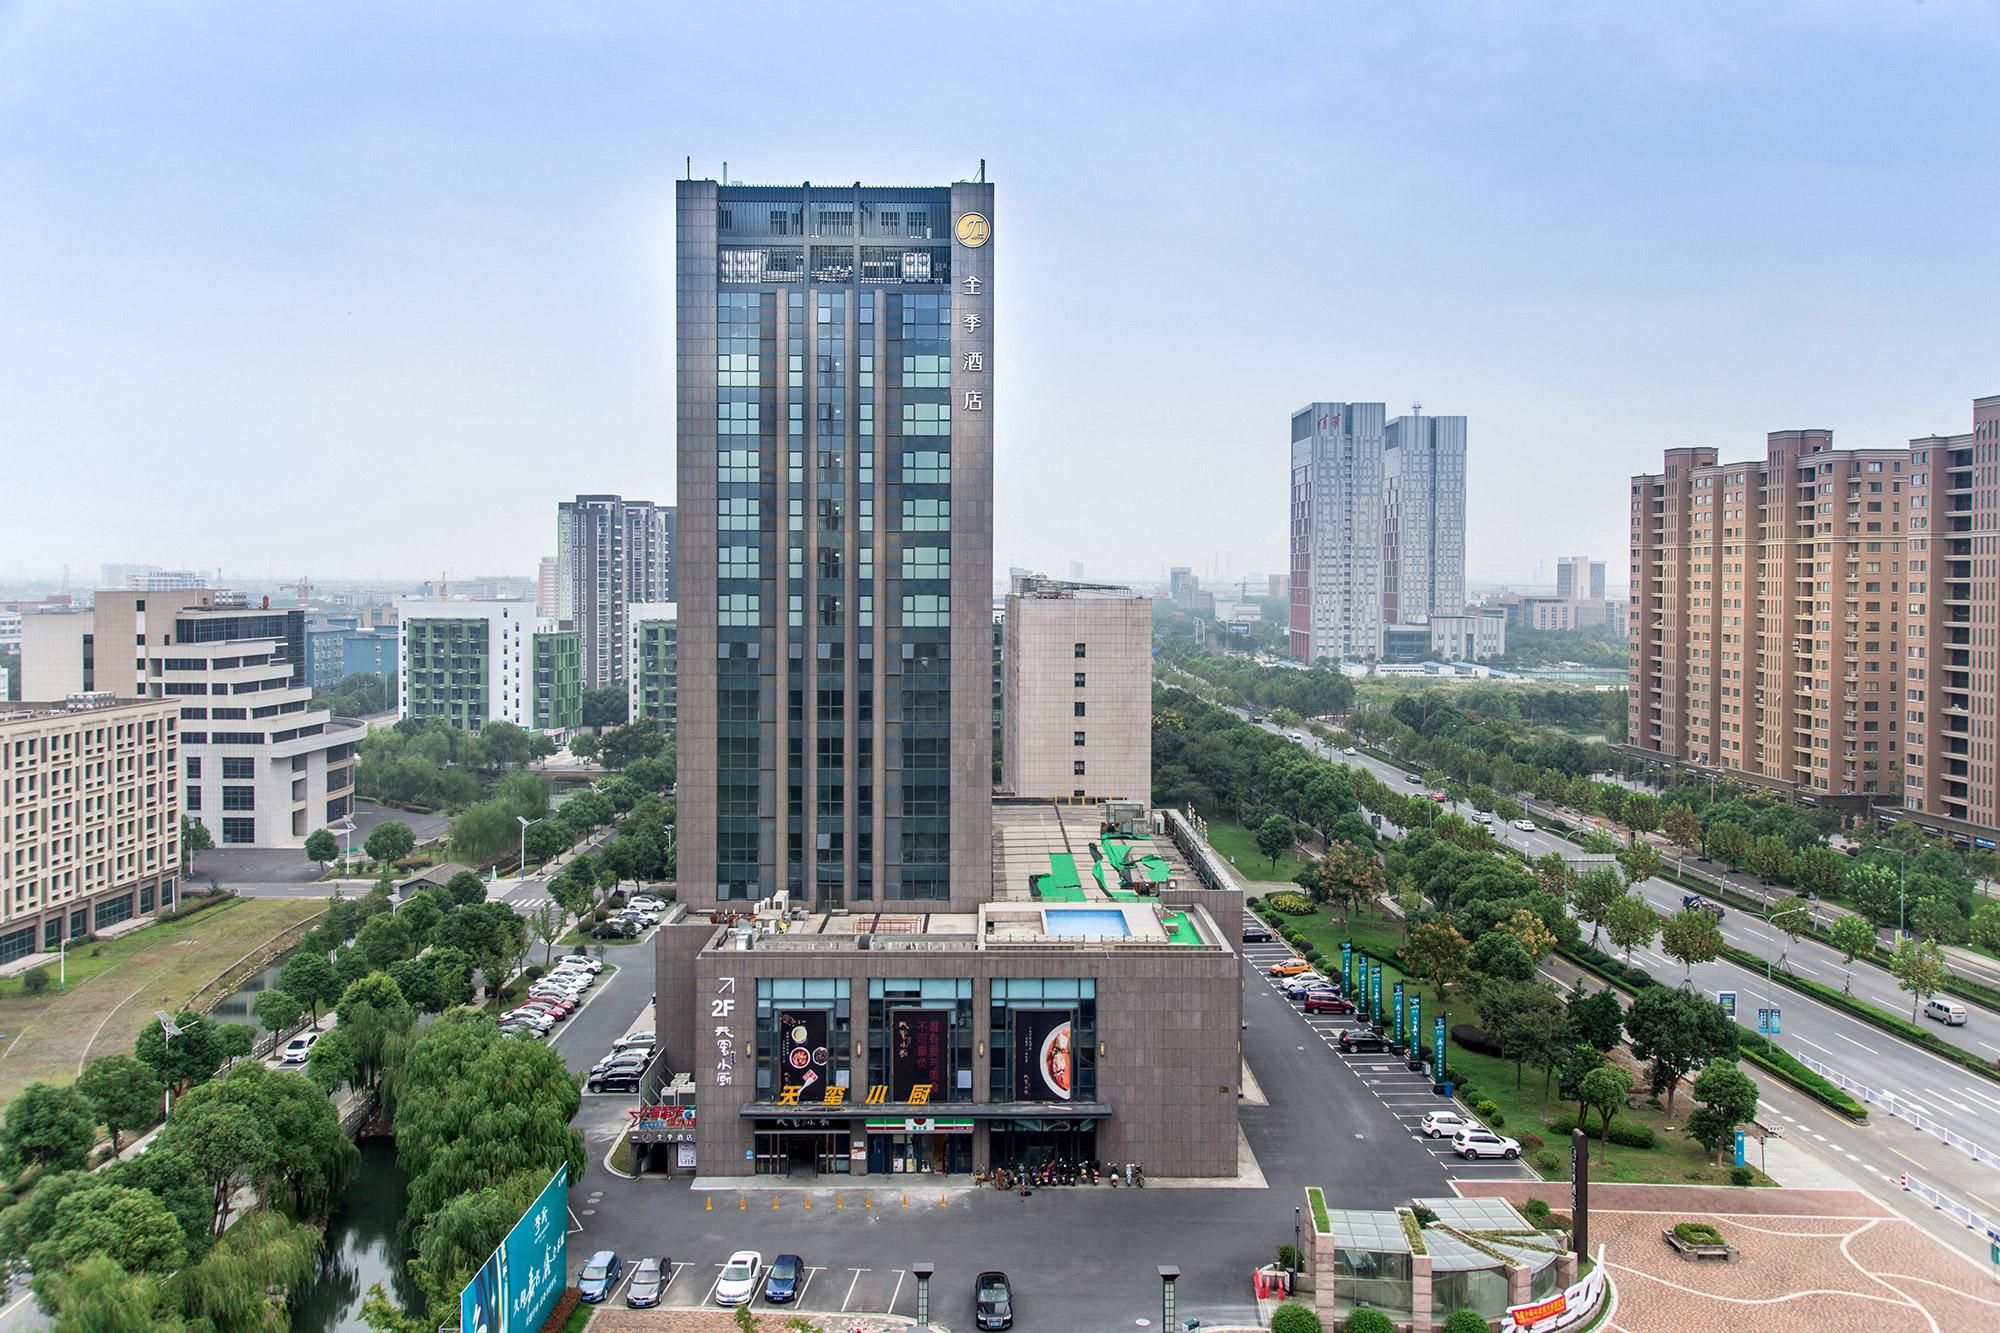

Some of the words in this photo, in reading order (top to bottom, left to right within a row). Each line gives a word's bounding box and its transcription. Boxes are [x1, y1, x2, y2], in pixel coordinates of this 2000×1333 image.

[962, 275, 983, 411] 全季酒店
[711, 999, 735, 1017] 2F
